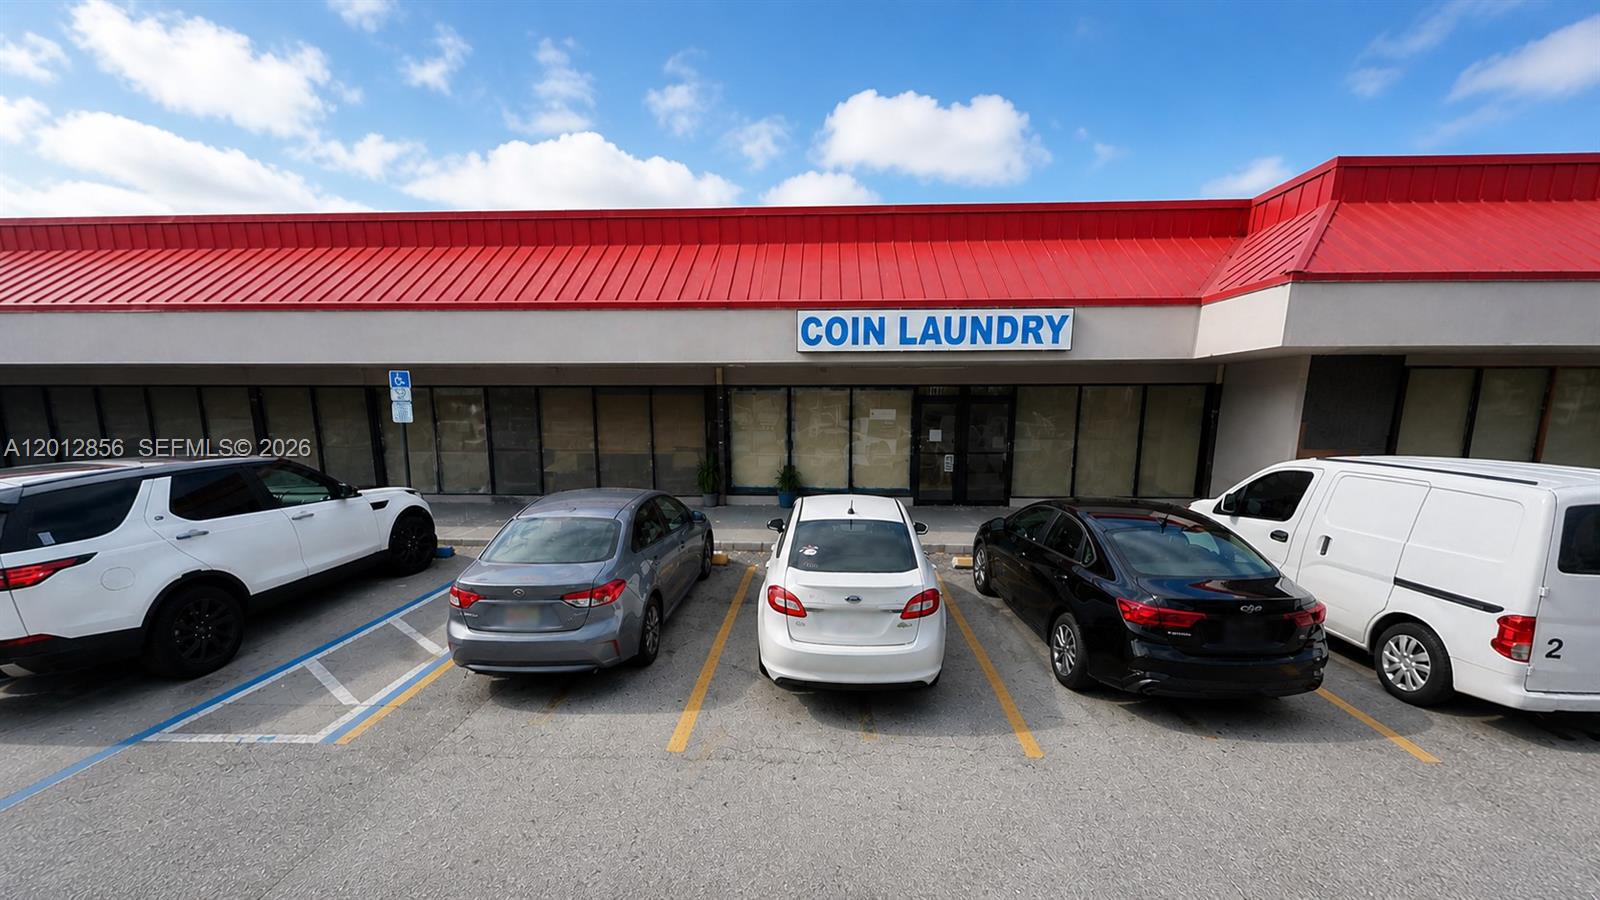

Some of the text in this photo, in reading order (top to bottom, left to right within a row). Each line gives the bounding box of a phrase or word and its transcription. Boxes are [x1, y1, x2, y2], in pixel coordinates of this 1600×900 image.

[800, 314, 1070, 346] COIN LAUNDRY
[1545, 638, 1563, 659] 2
